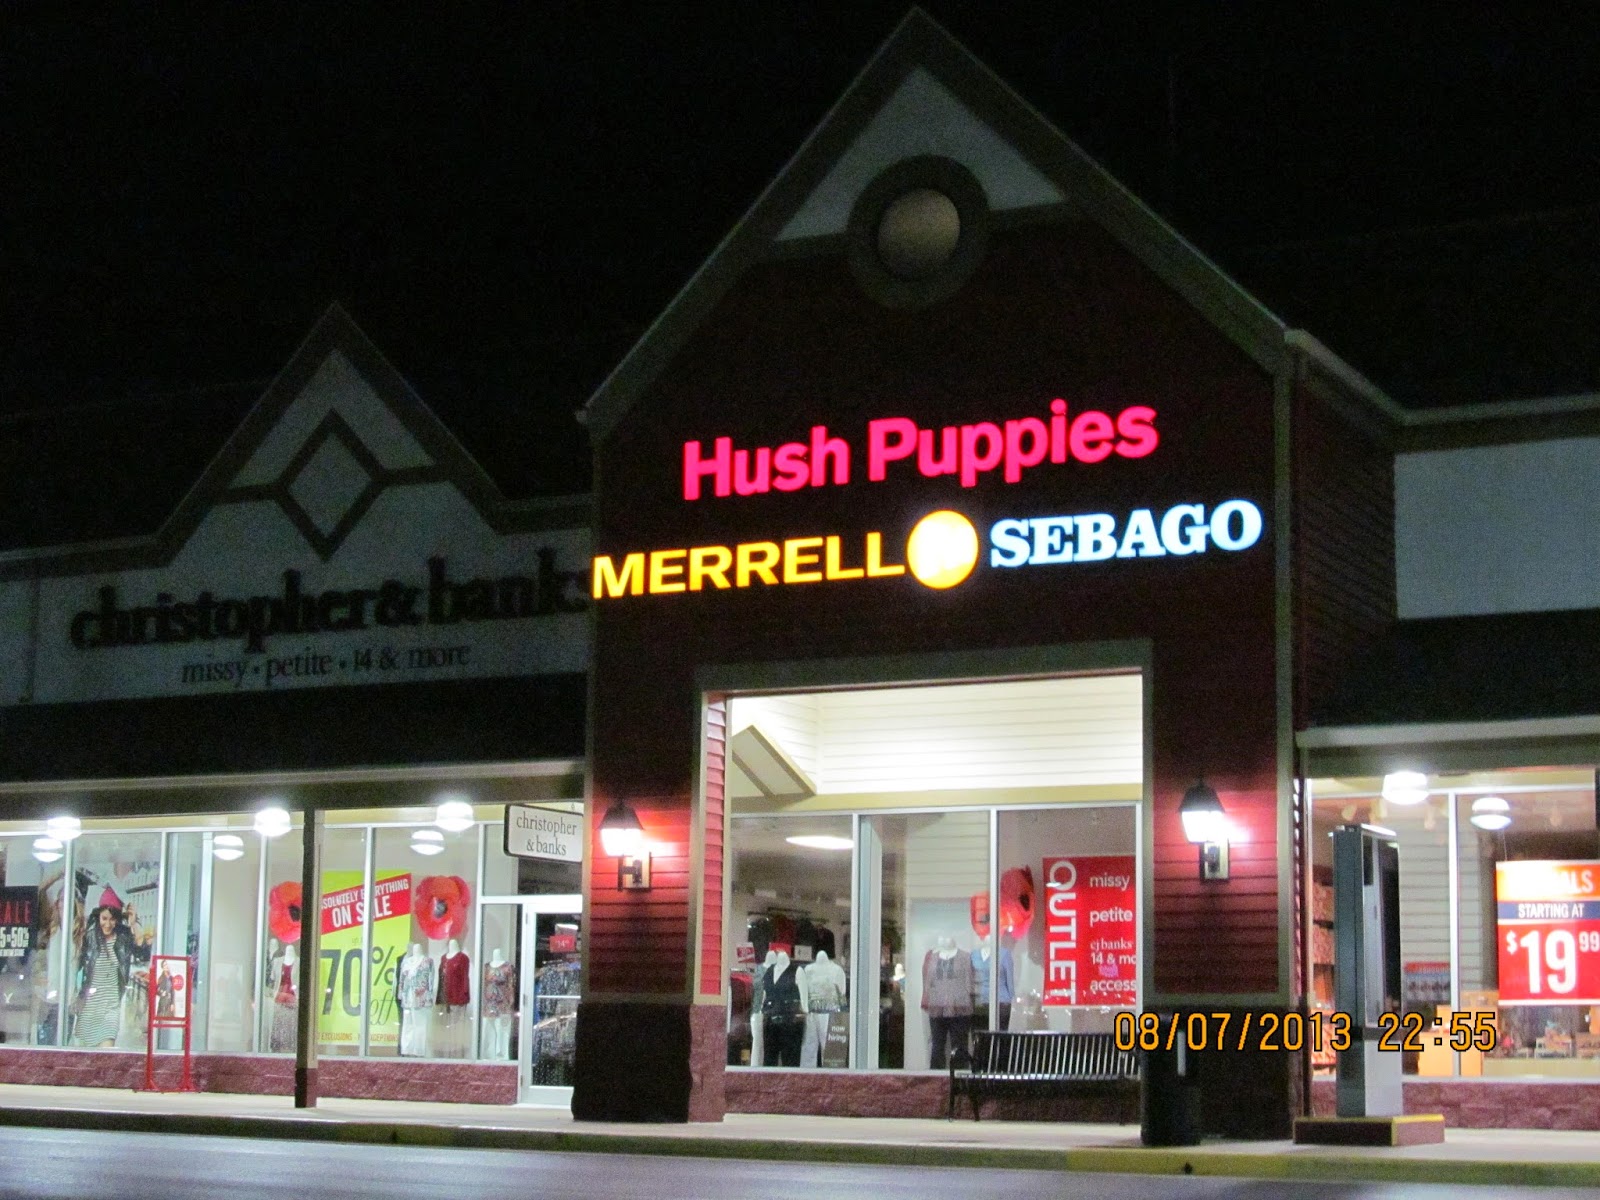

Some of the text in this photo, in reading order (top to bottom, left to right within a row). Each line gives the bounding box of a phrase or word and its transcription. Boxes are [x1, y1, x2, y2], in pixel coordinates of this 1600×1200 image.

[684, 399, 1159, 500] Hush Puppies
[989, 499, 1263, 568] SEBAGO
[592, 531, 905, 600] MERRELL
[181, 654, 248, 687] missy
[266, 646, 333, 685] petite
[408, 645, 471, 670] more
[516, 811, 578, 838] christopher
[1089, 873, 1130, 891] missy
[0, 902, 31, 924] ALE
[331, 896, 393, 928] ON SLE
[1089, 907, 1133, 926] petite
[1518, 903, 1585, 918] STARTING AT
[1049, 860, 1077, 1004] OUTLET
[1091, 953, 1103, 965] 14
[1106, 953, 1116, 965] &
